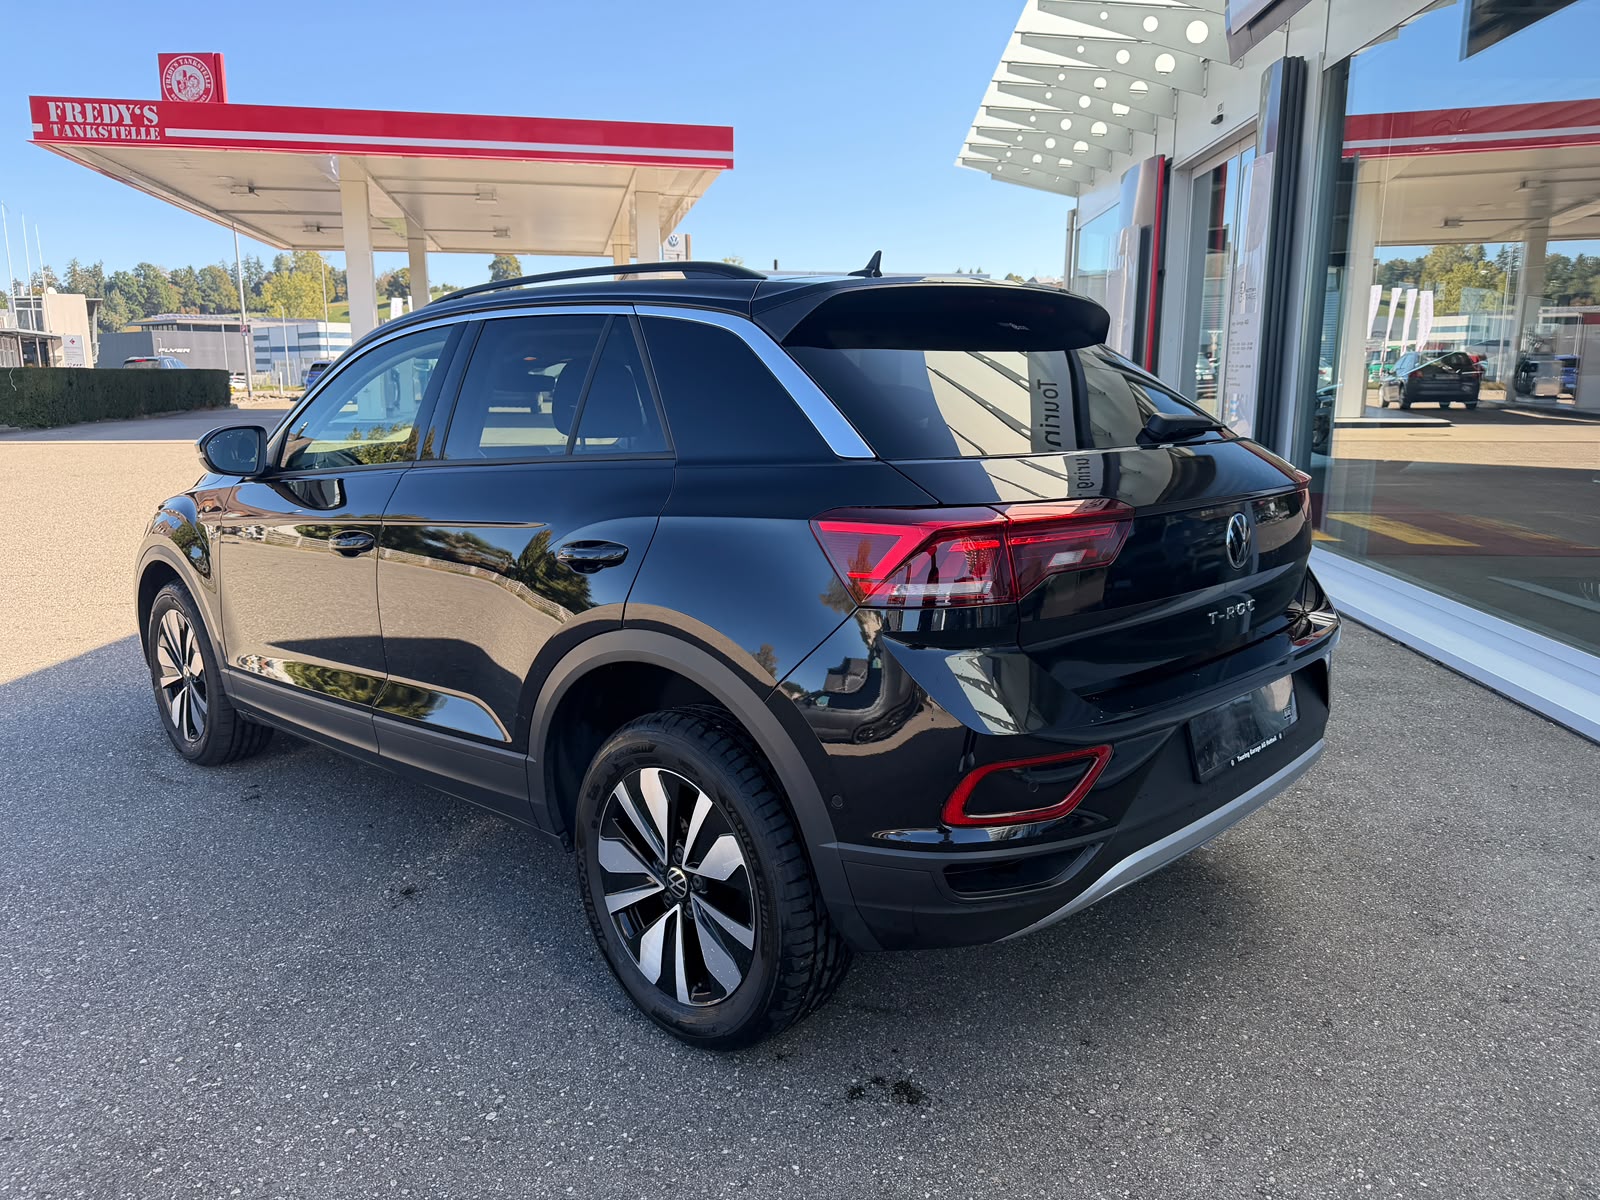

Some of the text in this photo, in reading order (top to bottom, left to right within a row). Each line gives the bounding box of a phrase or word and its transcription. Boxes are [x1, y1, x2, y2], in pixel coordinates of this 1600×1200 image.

[179, 58, 211, 89] TANKSTELLE
[50, 124, 160, 140] TANKSTELLE
[1207, 598, 1256, 625] T-ROC
